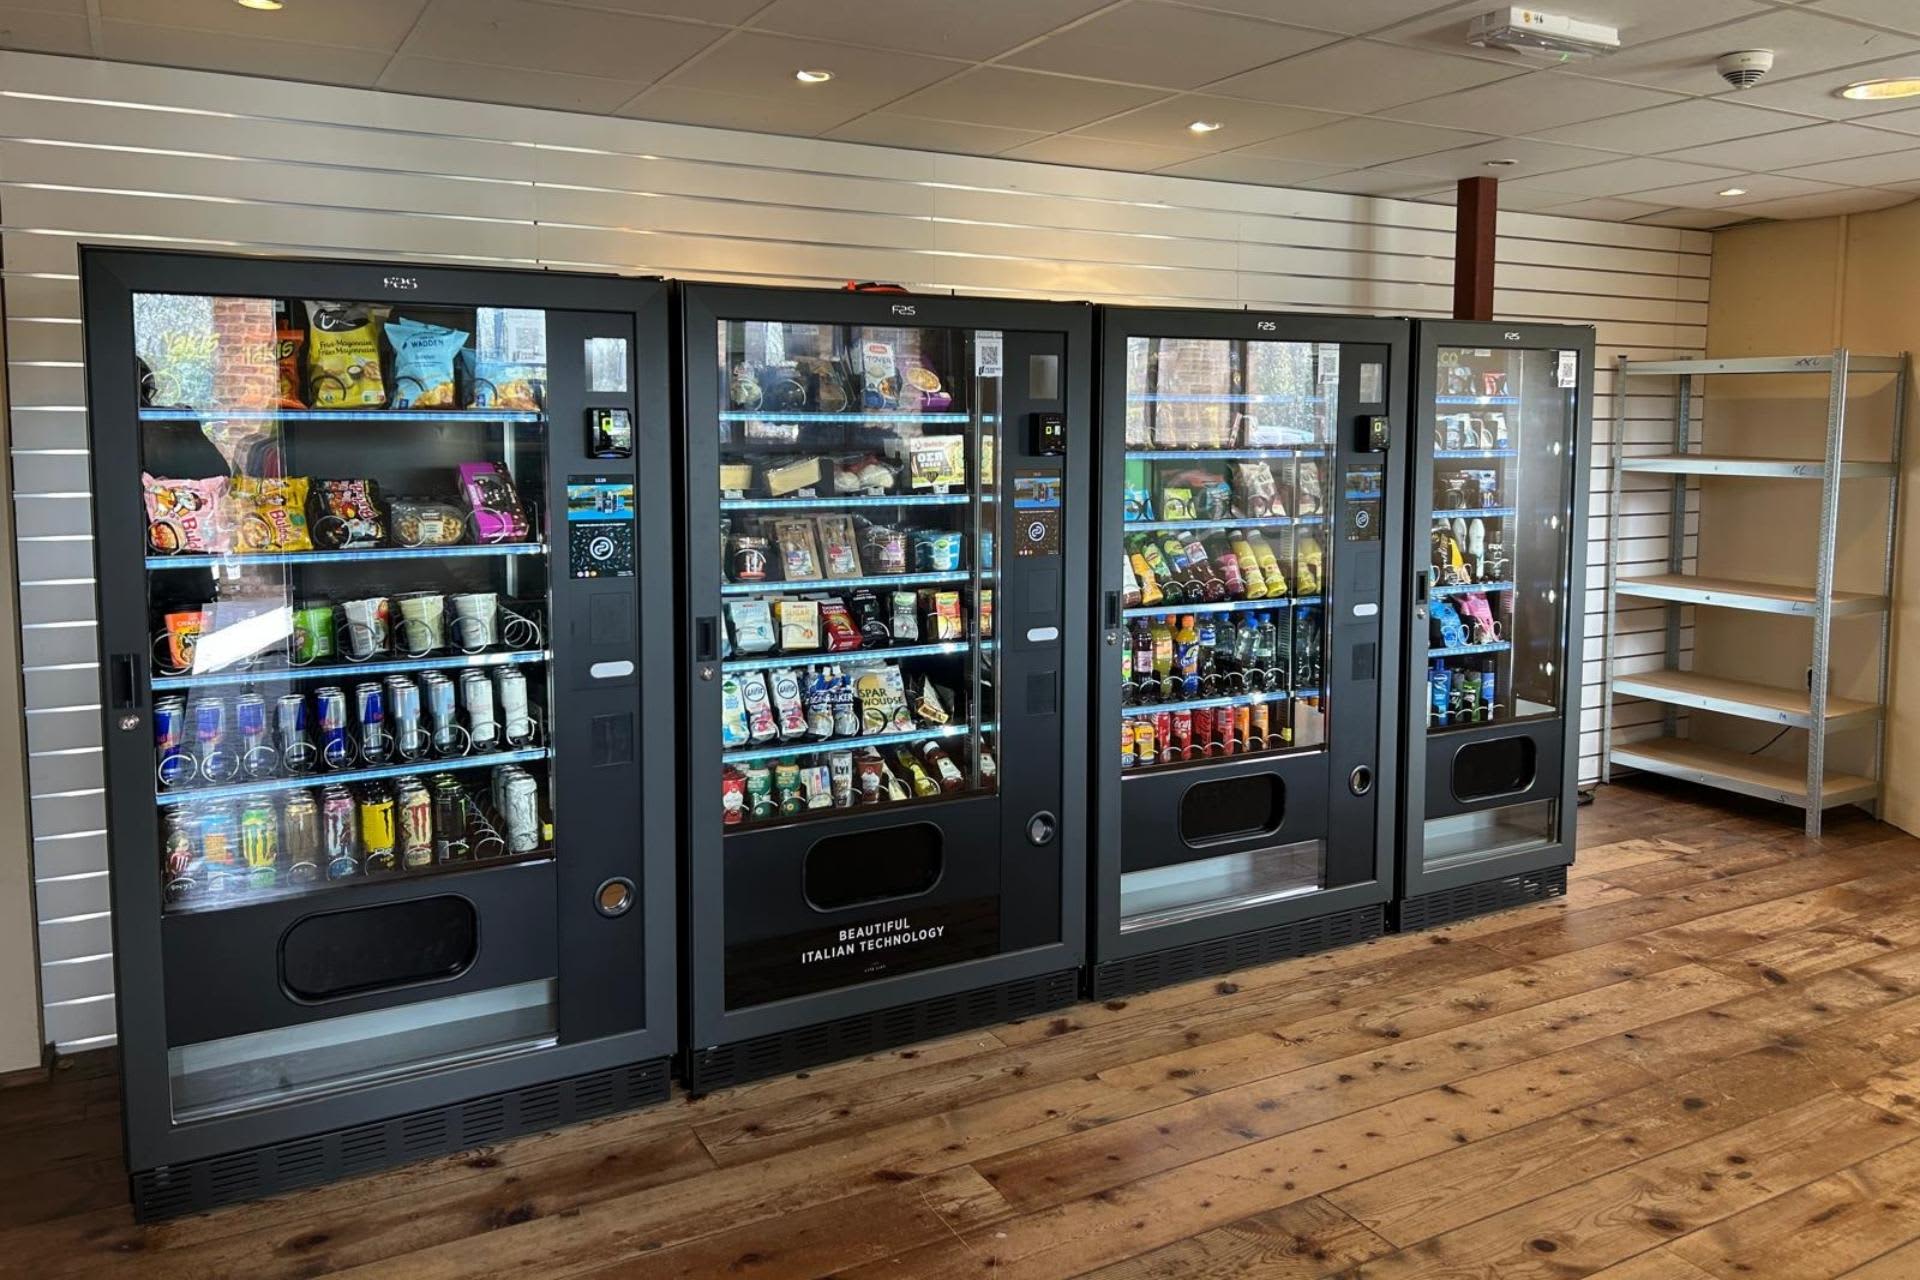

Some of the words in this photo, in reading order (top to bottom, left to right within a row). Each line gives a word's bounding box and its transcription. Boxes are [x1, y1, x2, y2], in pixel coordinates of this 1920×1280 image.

[1793, 465, 1807, 476] XL
[859, 687, 887, 699] SPAR
[838, 917, 911, 942] BEAUTIFUL
[801, 943, 855, 964] ITALIAN
[859, 925, 945, 952] TECHNOLOGY
